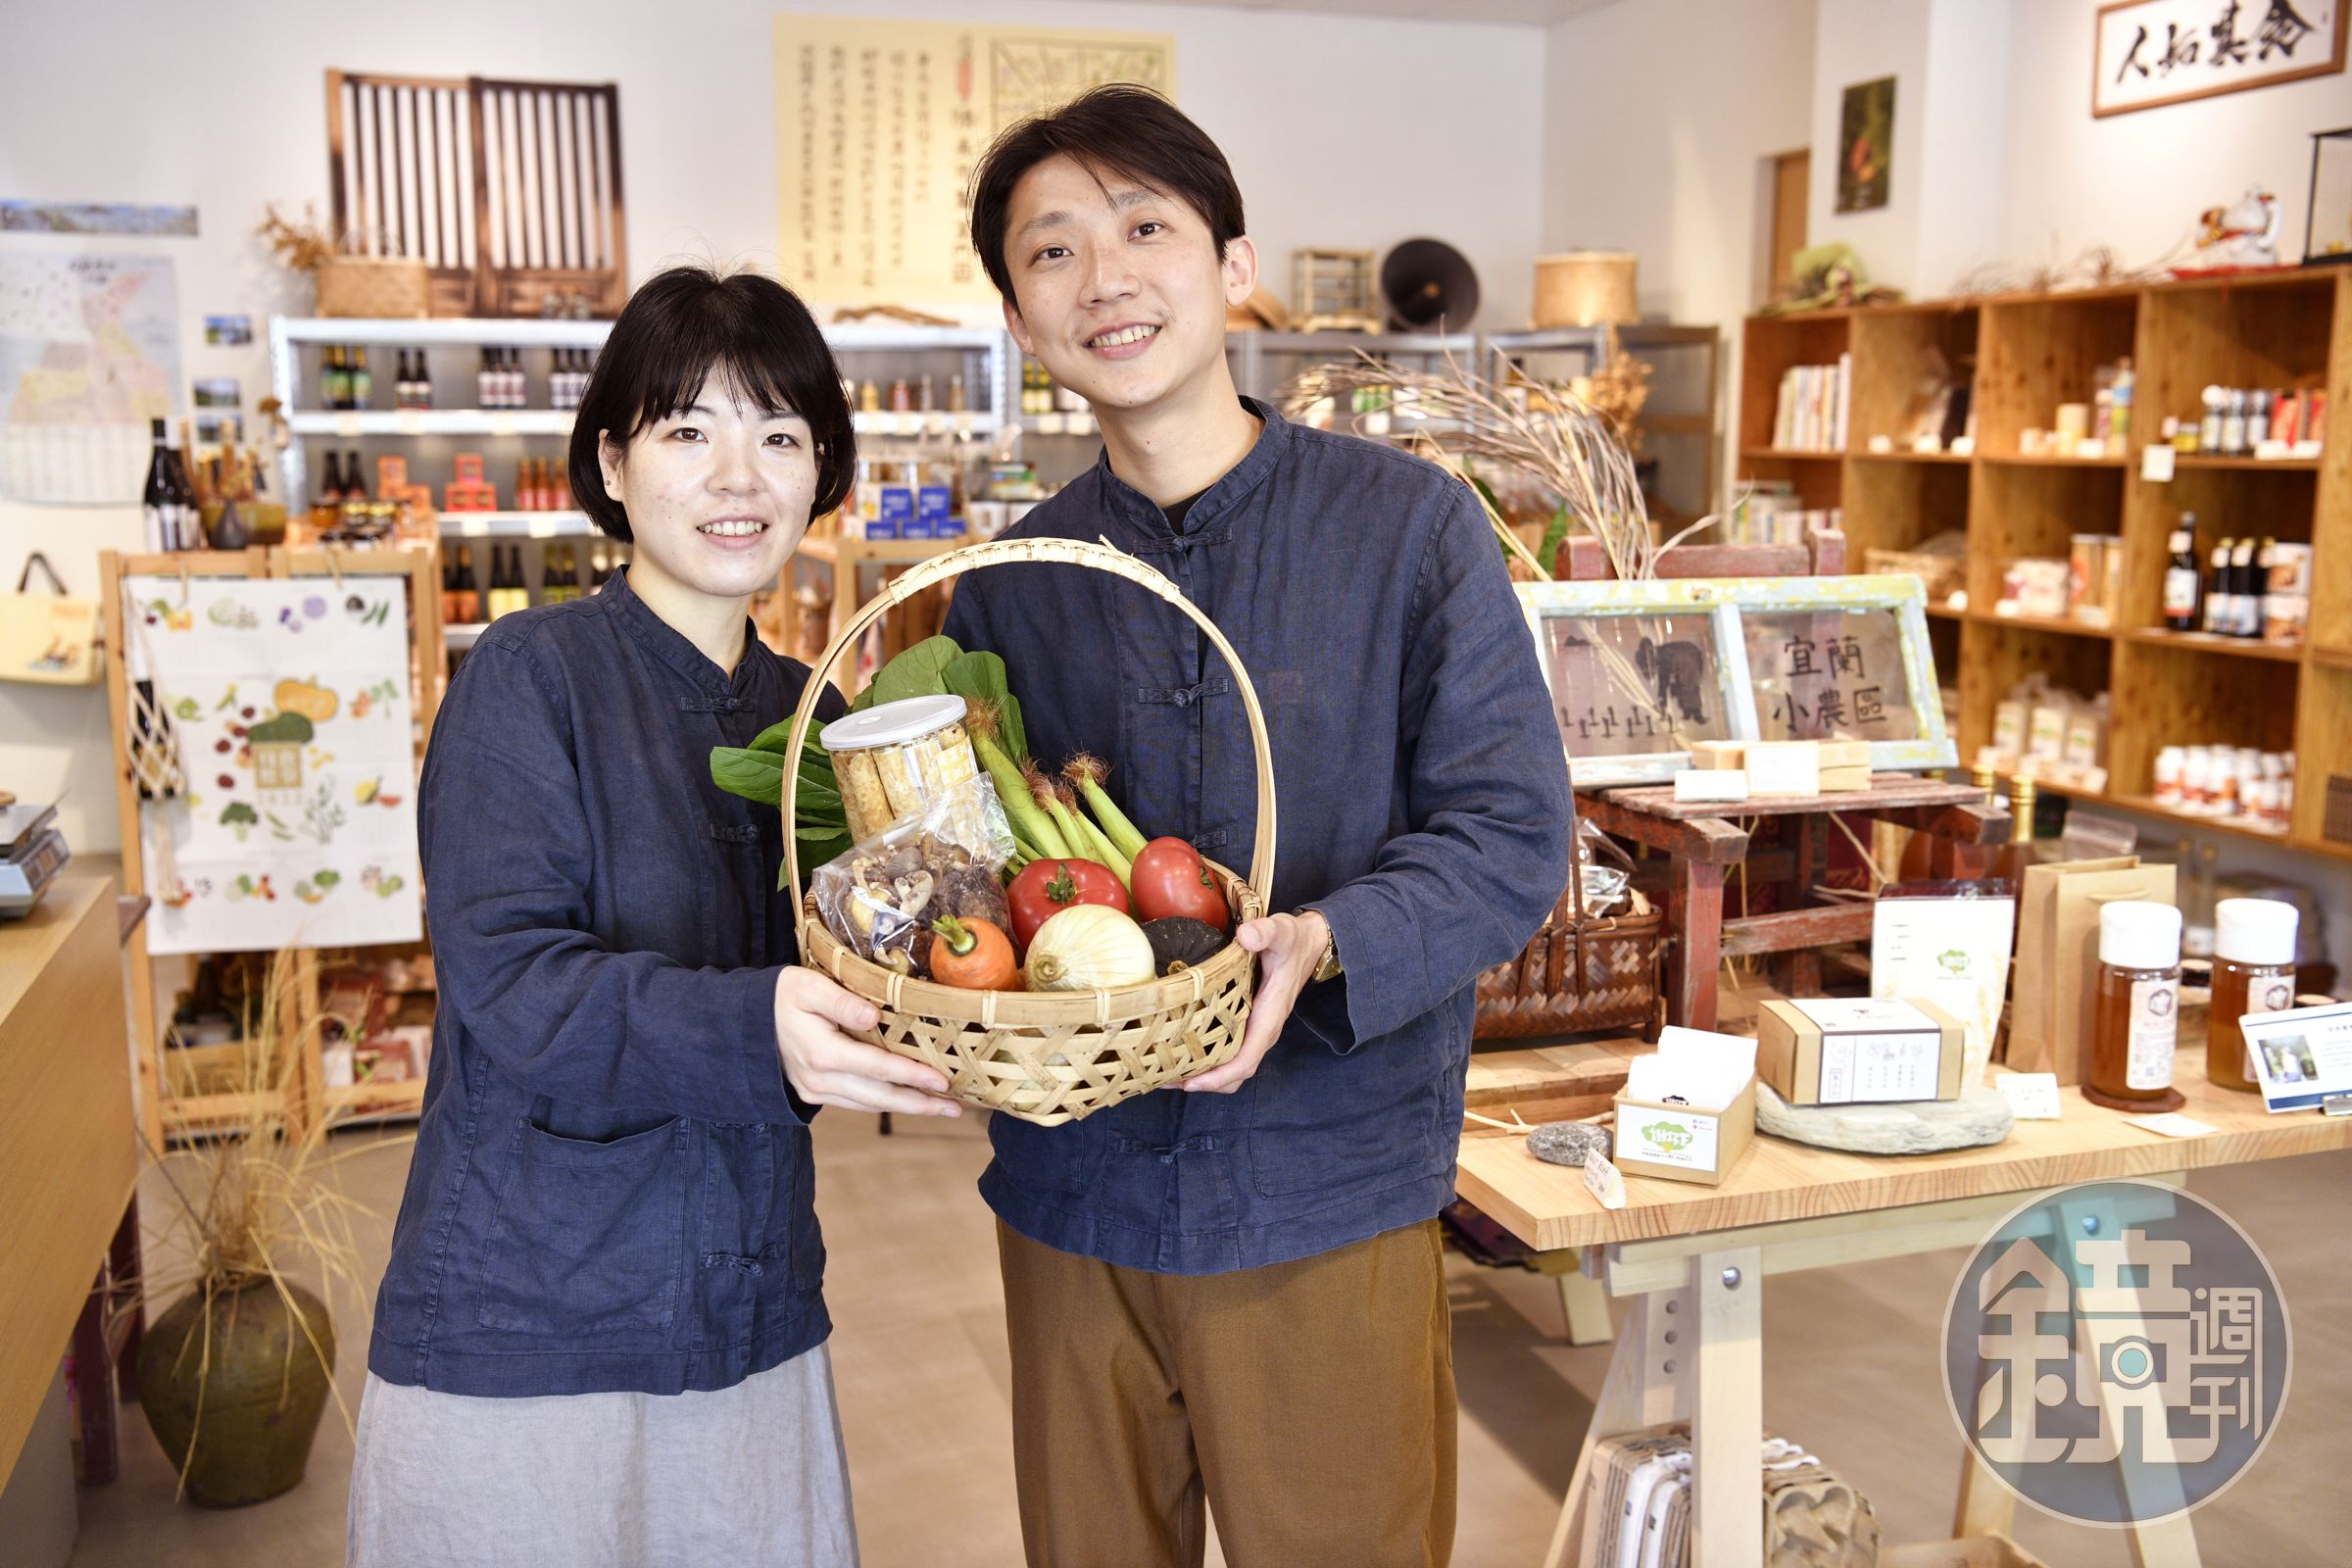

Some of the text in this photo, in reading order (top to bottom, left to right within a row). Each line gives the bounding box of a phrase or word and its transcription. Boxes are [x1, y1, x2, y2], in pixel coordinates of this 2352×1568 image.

[1784, 635, 1865, 679] 宜蘭
[1773, 686, 1886, 732] 小農區
